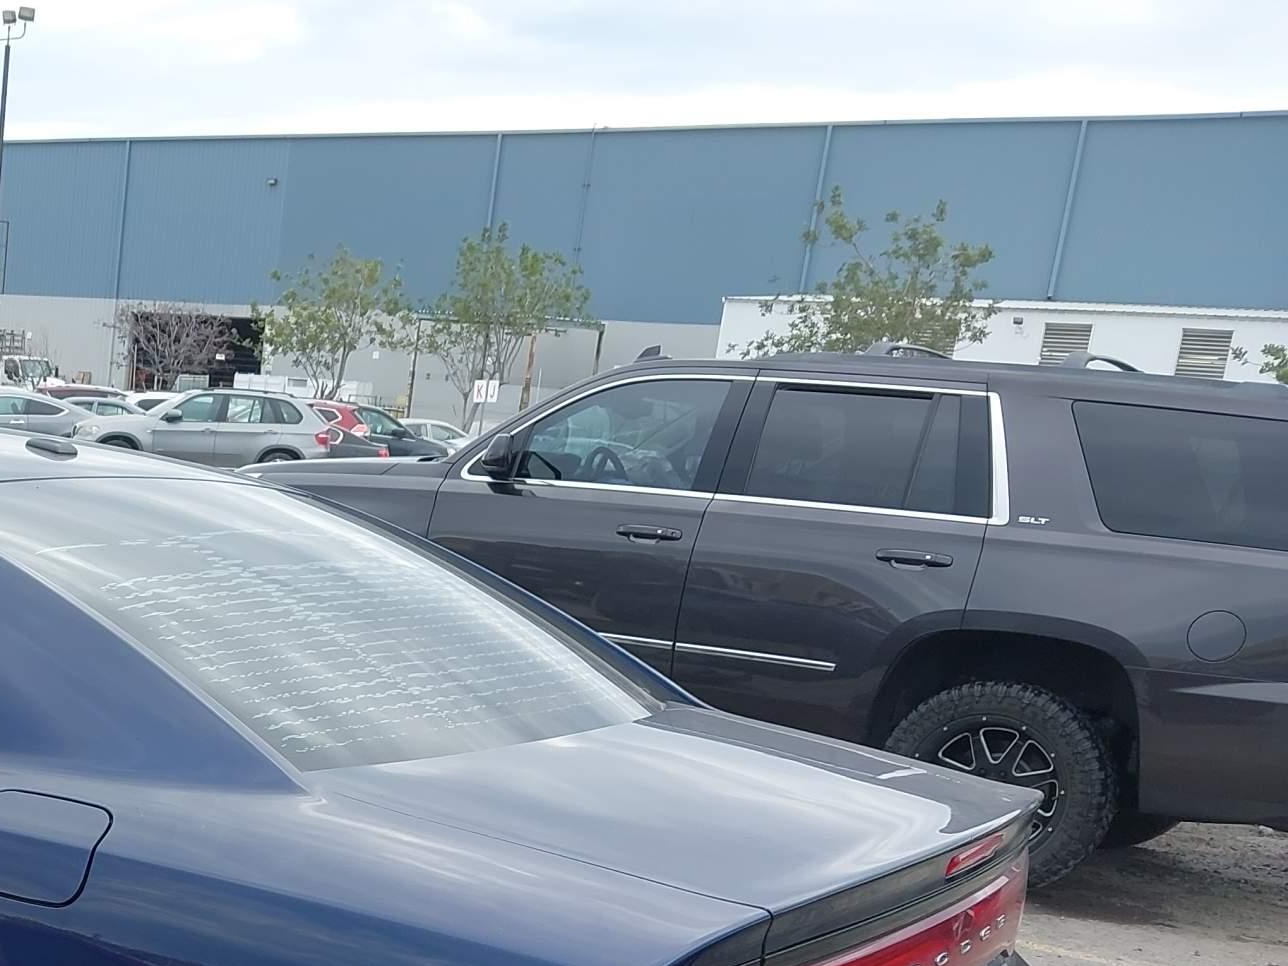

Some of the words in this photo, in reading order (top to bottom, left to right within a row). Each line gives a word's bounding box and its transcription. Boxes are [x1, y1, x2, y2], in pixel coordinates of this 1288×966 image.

[476, 384, 484, 400] K
[489, 383, 497, 399] J
[1017, 515, 1051, 526] SLT
